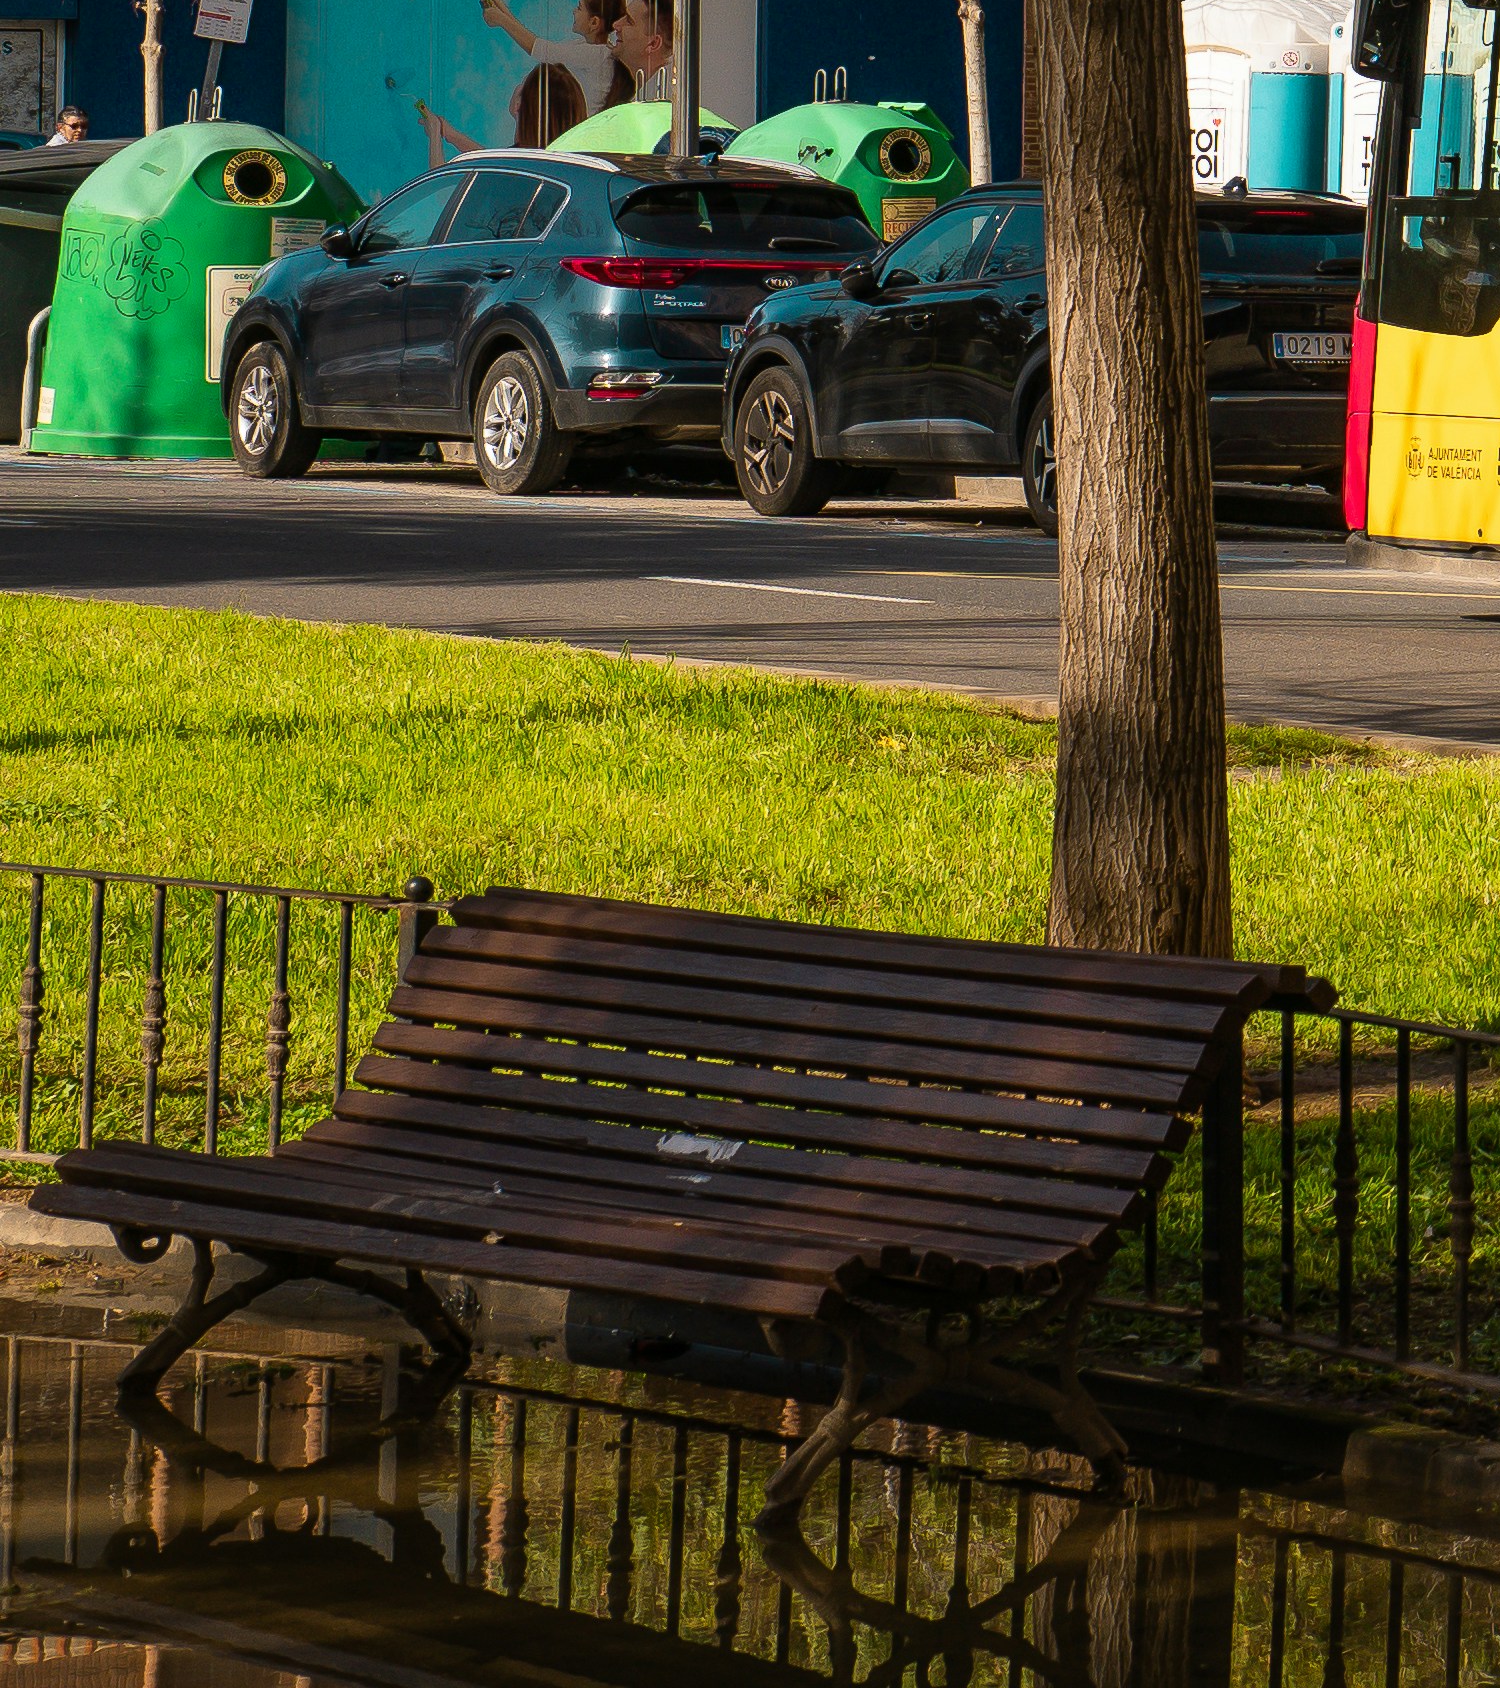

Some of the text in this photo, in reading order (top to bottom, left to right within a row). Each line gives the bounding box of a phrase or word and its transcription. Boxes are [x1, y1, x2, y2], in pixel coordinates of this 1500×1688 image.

[770, 278, 790, 289] KIA
[1287, 336, 1336, 355] 0219
[1428, 447, 1482, 462] AJUNTAMENT
[1427, 465, 1438, 479] DE
